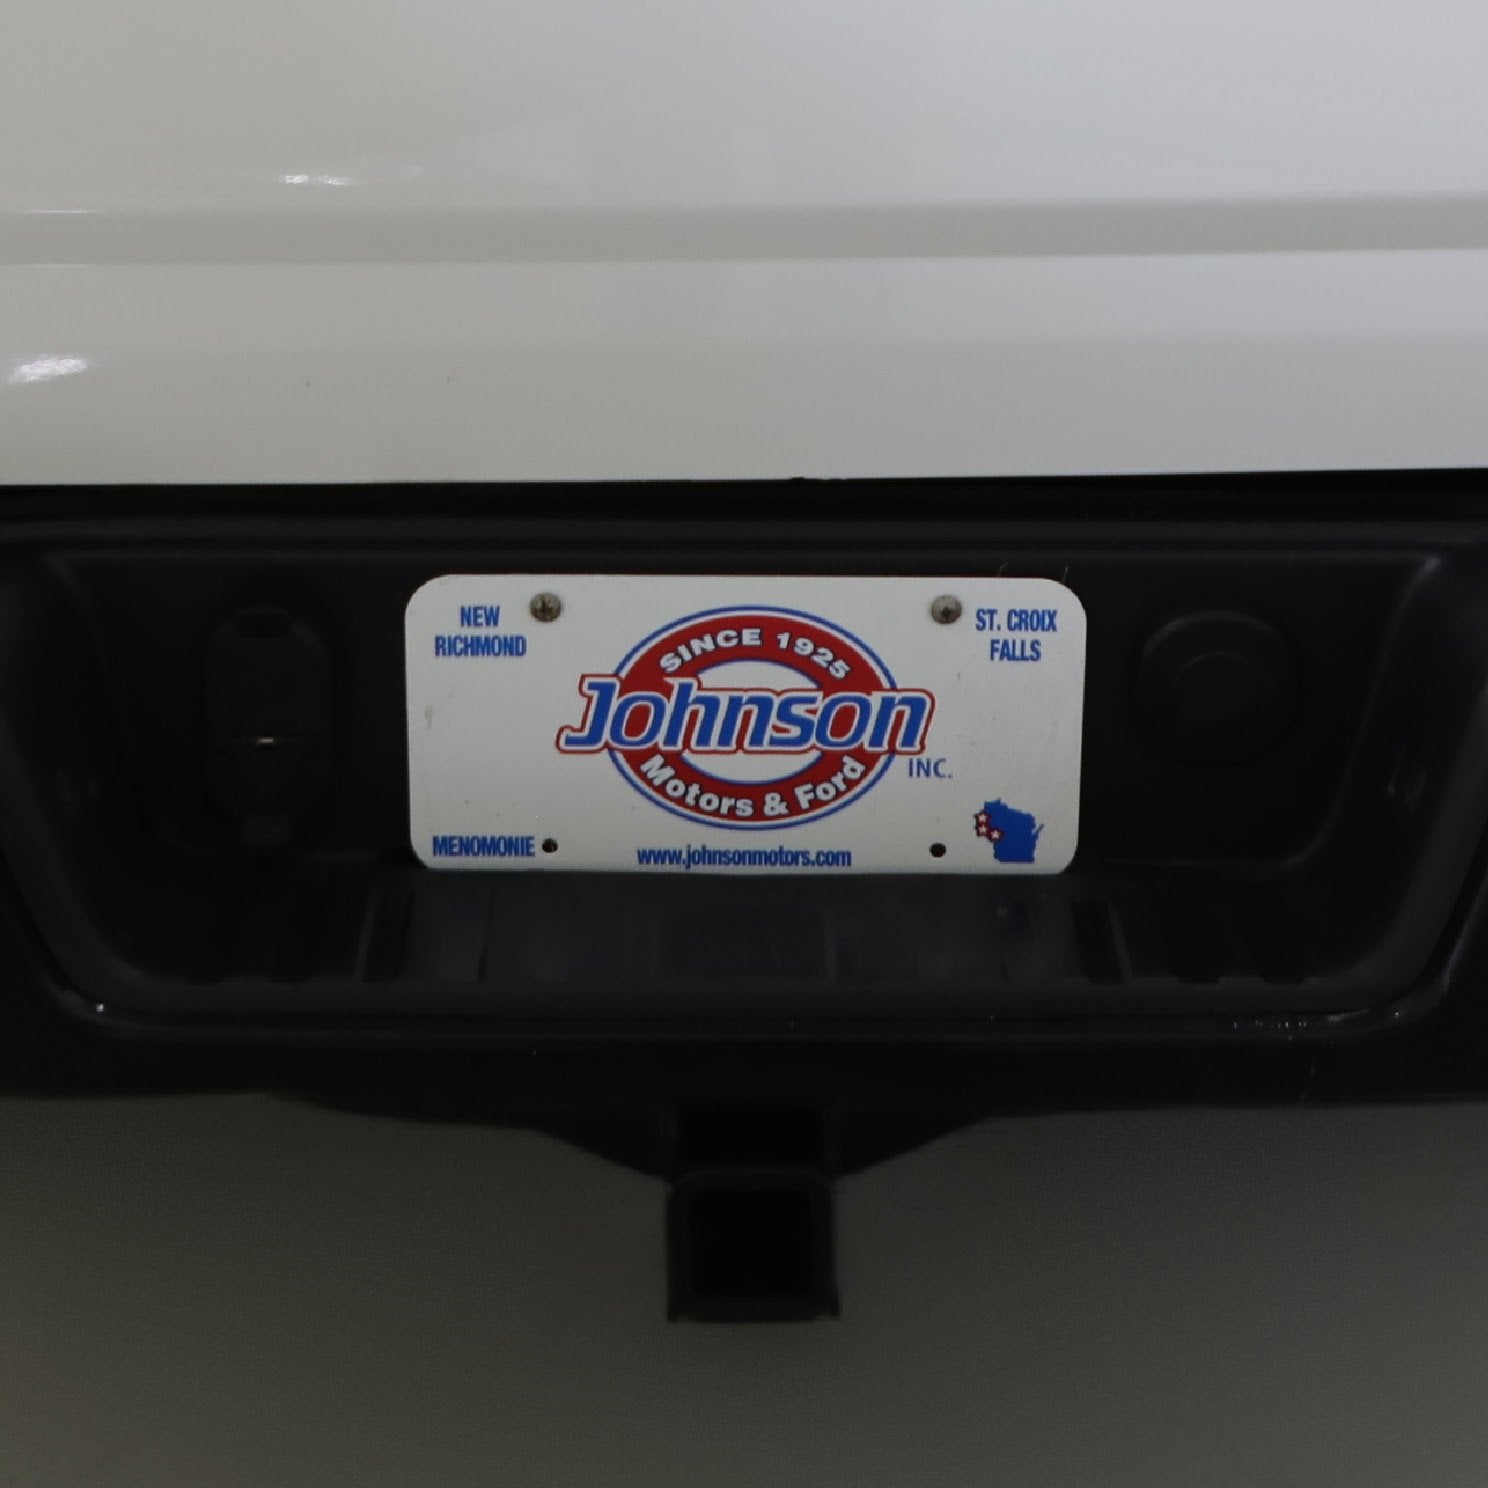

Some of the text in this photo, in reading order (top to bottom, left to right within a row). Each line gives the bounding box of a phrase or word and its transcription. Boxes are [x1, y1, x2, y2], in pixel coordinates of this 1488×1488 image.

[460, 605, 501, 628] NEW
[975, 608, 1058, 633] ST. CROIX
[434, 635, 528, 658] RICHMOND
[658, 628, 850, 680] SINCE 1925
[989, 639, 1043, 663] FALLS
[556, 673, 936, 756] Johnson
[908, 758, 953, 780] INC.
[640, 755, 867, 818] Motors & Ford
[432, 835, 536, 859] MENOMONIE
[637, 844, 852, 869] www.johnsonmotors.com
